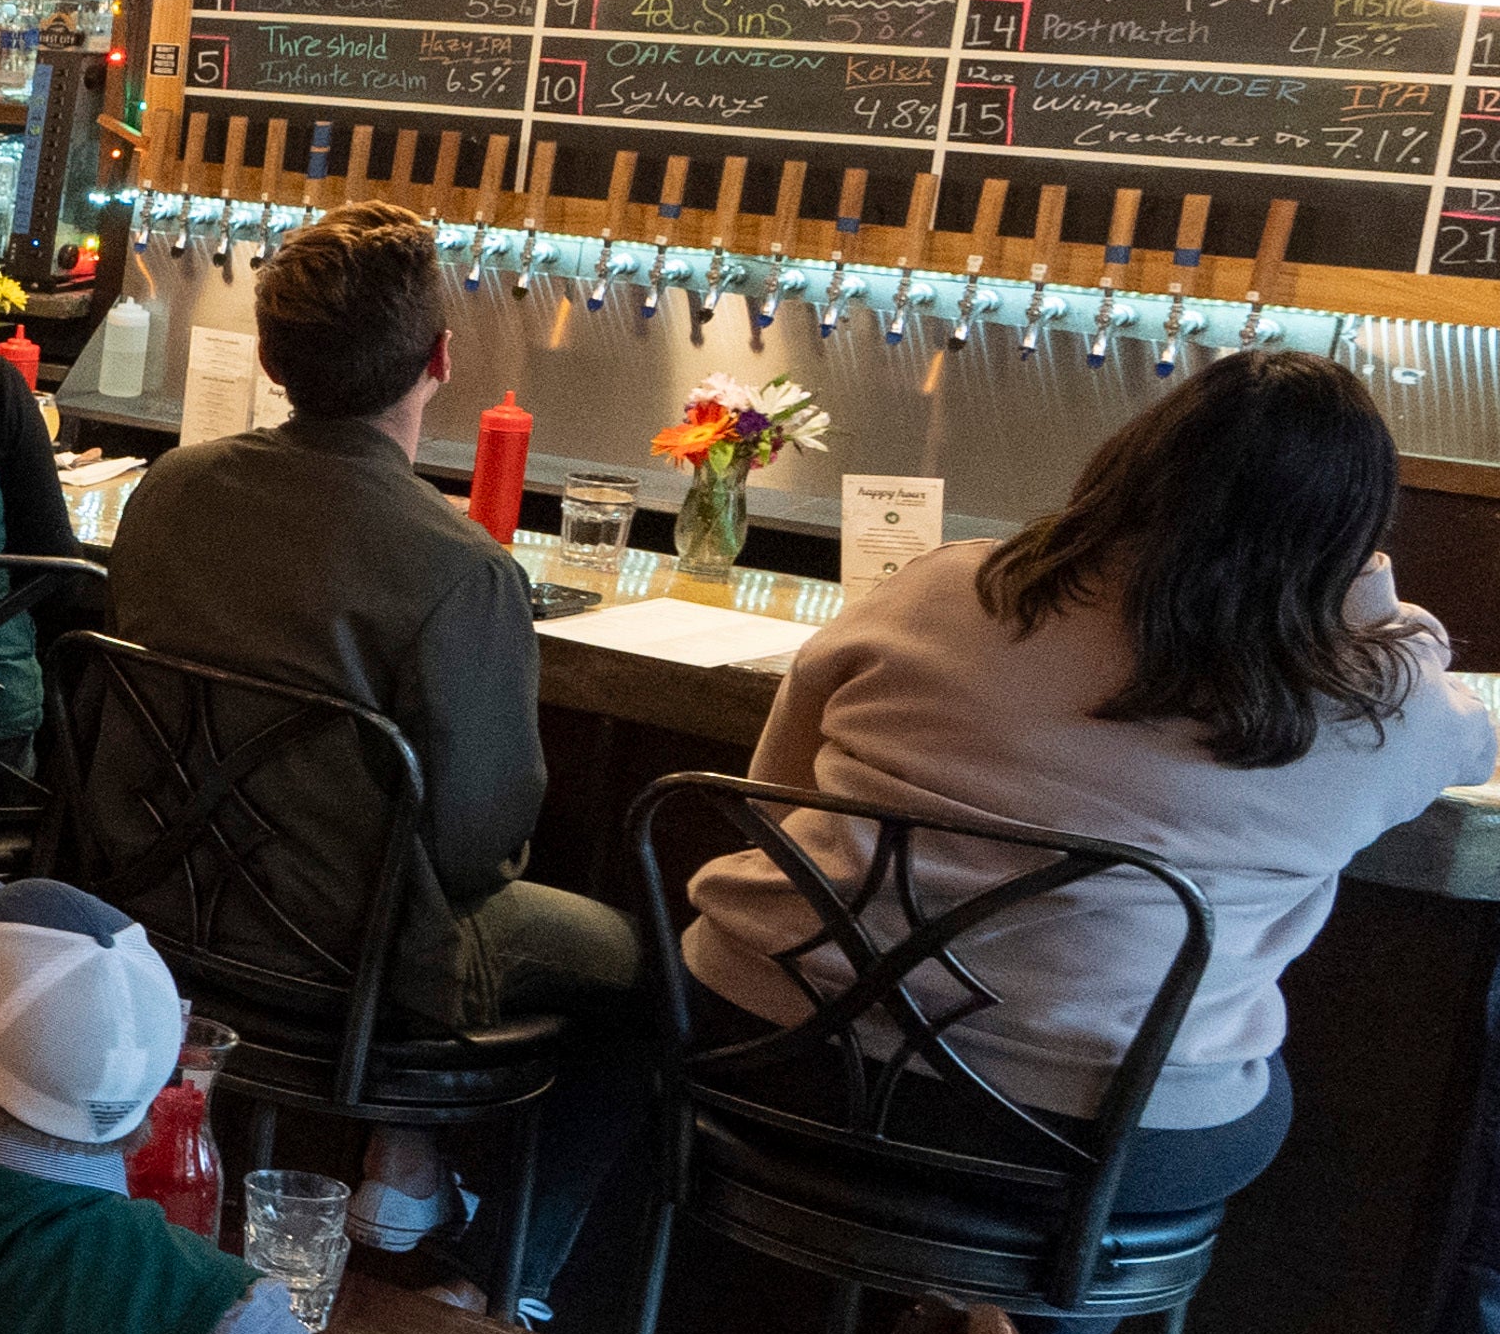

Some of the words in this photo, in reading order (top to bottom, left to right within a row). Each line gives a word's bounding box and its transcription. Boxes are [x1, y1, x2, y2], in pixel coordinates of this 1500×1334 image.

[257, 25, 390, 62] Threshold
[966, 12, 1017, 48] 14
[192, 50, 221, 86] 5
[606, 41, 684, 68] OAK
[694, 44, 828, 71] UNION
[360, 66, 429, 91] realm
[445, 65, 512, 100] 6.5%
[536, 75, 577, 107] 10
[1032, 67, 1309, 104] WAYFINDER
[1338, 83, 1433, 111] IPA
[596, 74, 769, 119] Sylvanys
[853, 94, 939, 137] 4.8%
[949, 102, 1007, 136] 15
[1032, 94, 1161, 120] Winged
[1071, 123, 1261, 148] Creatures
[1320, 125, 1430, 165] 7.1%
[1438, 224, 1499, 265] 21
[857, 486, 896, 500] happy
[897, 487, 927, 500] hour
